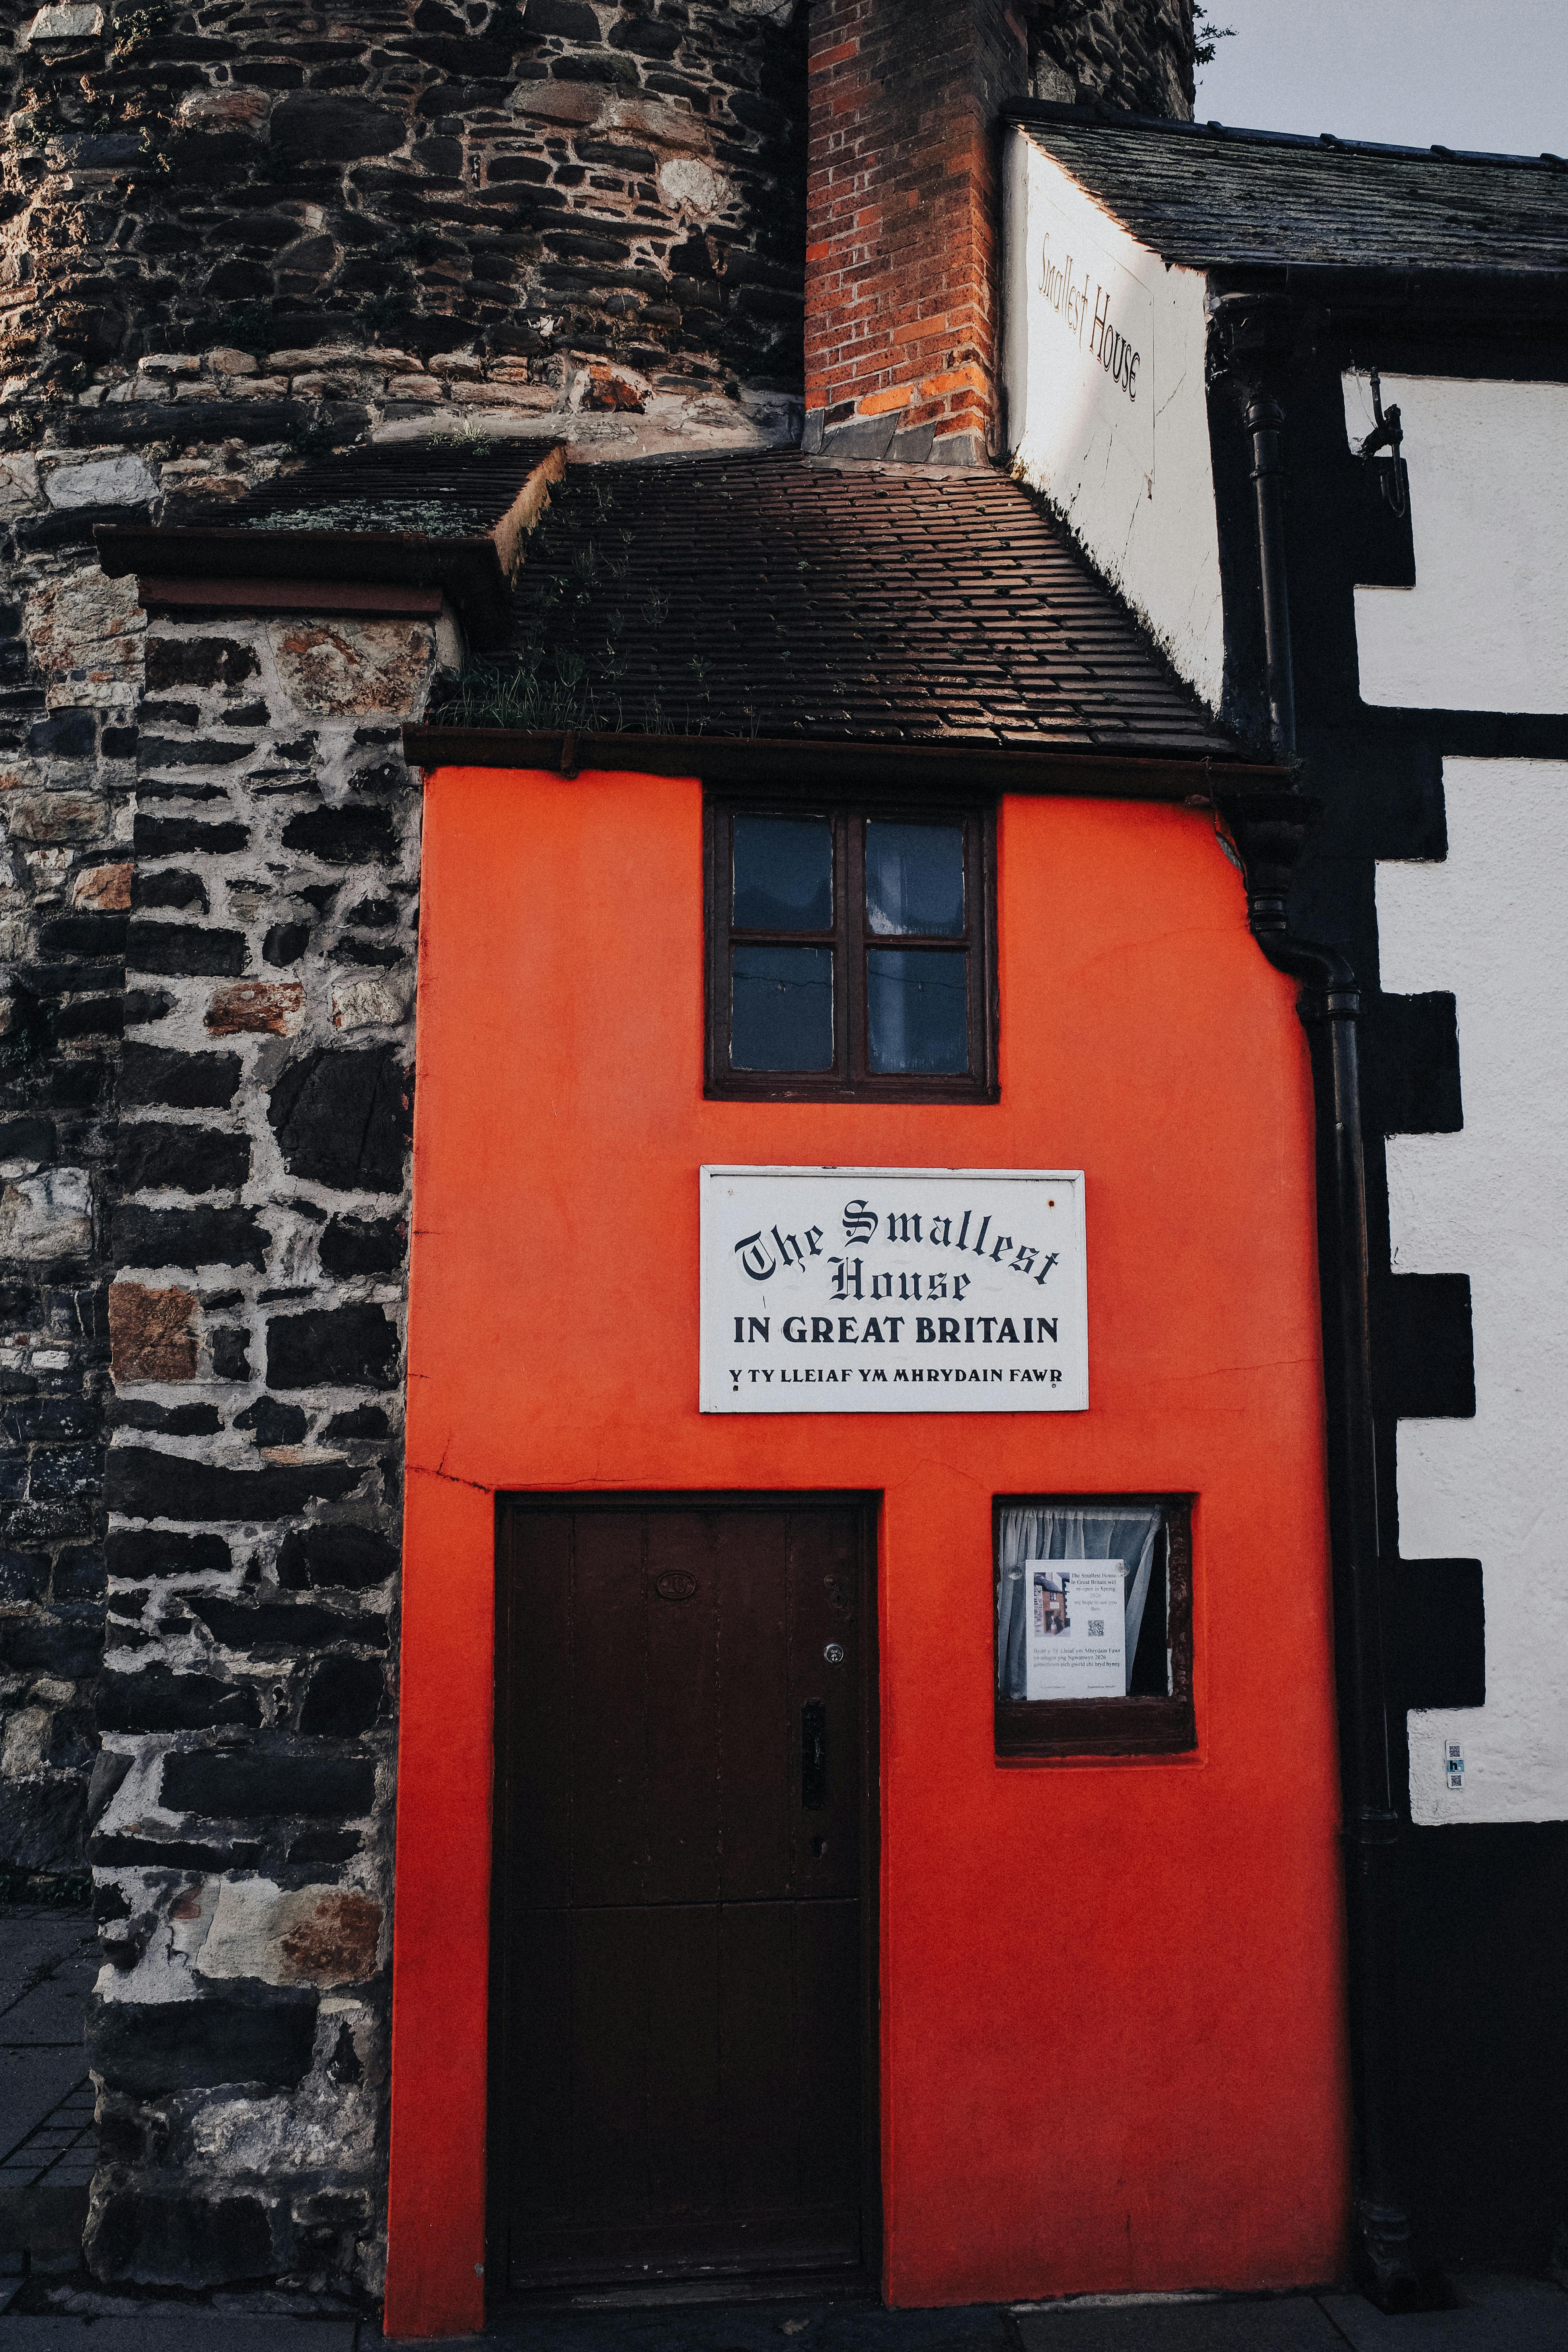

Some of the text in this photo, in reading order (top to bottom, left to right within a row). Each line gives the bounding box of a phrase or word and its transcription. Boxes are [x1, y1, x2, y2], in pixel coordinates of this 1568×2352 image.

[1038, 232, 1090, 353] Smallest
[734, 1199, 1060, 1285] The Smallest
[827, 1256, 971, 1301] House
[734, 1316, 1058, 1343] IN GREAT BRITAIN
[728, 1369, 1062, 1382] Y TY LLEIAF YM MHRYDAIN FAWR
